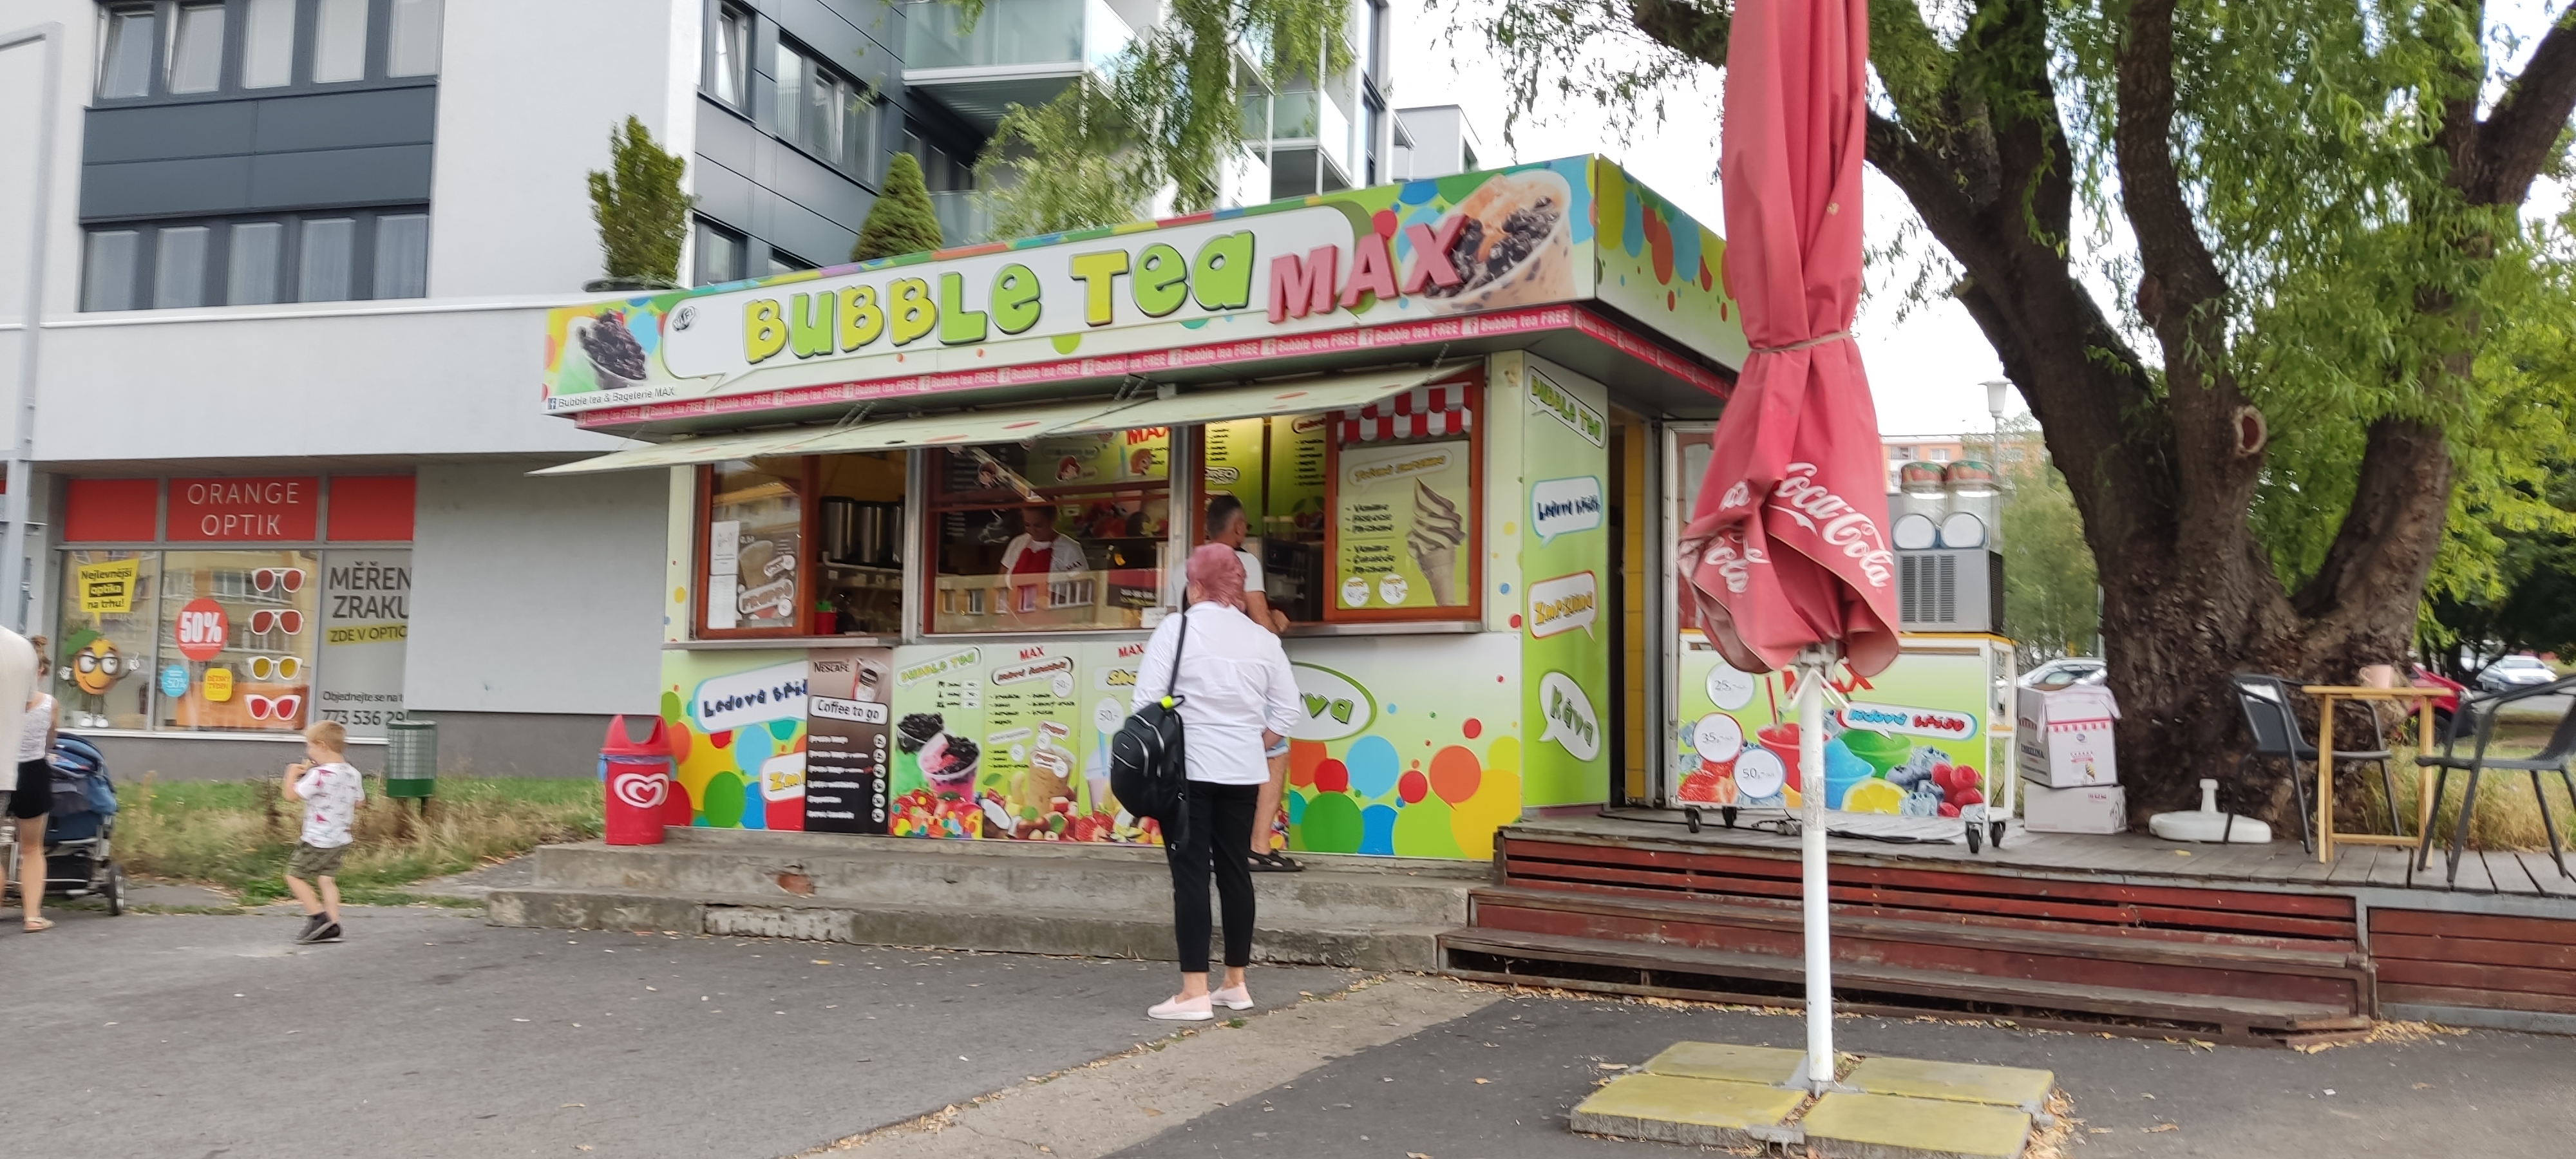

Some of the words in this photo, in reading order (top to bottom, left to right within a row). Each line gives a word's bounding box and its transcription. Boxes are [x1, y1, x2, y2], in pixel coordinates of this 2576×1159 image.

[1267, 214, 1468, 323] MAX
[558, 397, 587, 408] Bubble
[589, 395, 601, 404] tea
[603, 393, 611, 402] &
[612, 391, 652, 404] Bageterie
[654, 386, 675, 397] MAX
[187, 482, 299, 505] ORANGE
[201, 514, 281, 536] OPTIK
[86, 600, 99, 608] na
[180, 611, 222, 643] 50%
[330, 629, 355, 643] ZDE
[357, 628, 366, 640] V
[1019, 646, 1045, 660] MAX
[1118, 643, 1144, 658] MAX
[323, 690, 374, 704] Objednejte
[353, 710, 381, 726] 536
[817, 699, 849, 715] Coffee
[853, 706, 864, 716] to
[866, 708, 880, 721] go
